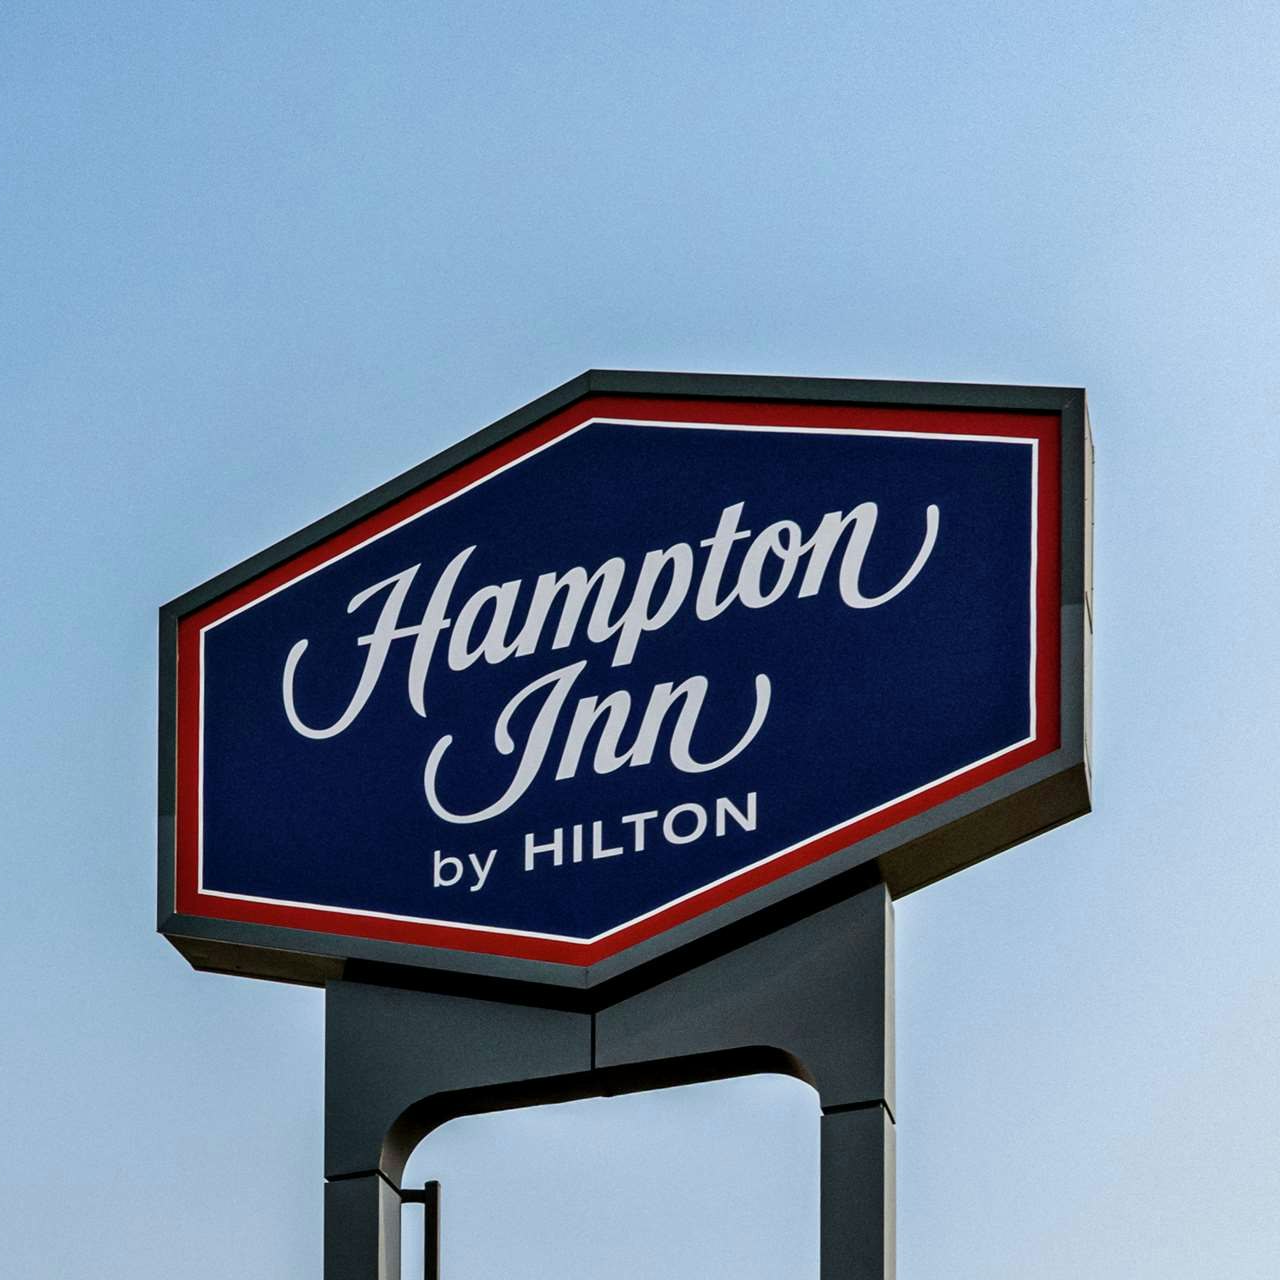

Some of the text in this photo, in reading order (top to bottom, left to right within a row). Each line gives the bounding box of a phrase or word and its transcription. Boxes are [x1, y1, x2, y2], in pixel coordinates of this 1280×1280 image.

[282, 501, 940, 740] Hampton
[423, 659, 772, 824] Inn
[433, 791, 757, 892] by HILTON
